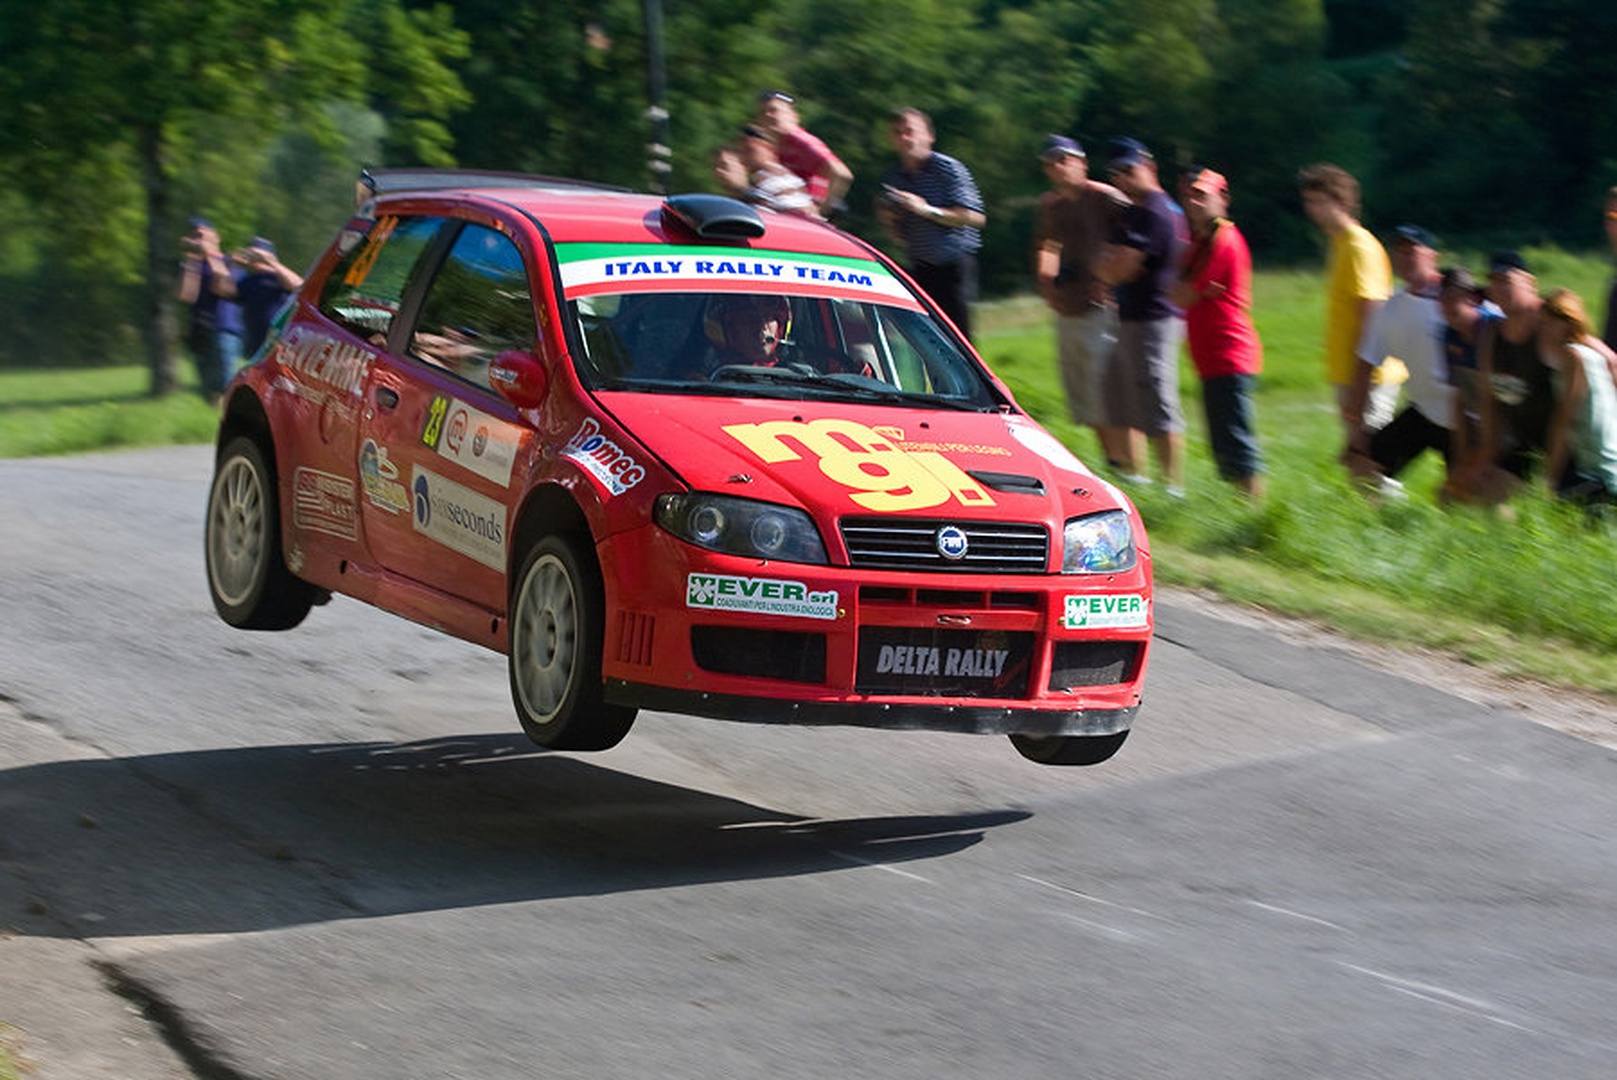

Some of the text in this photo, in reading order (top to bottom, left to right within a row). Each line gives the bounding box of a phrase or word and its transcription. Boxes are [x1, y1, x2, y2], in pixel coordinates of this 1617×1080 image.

[605, 260, 874, 287] ITALY RALLY TEAM
[423, 396, 447, 447] 23
[570, 418, 644, 487] Romec
[718, 579, 835, 604] EVER srl
[1089, 598, 1140, 613] EVER
[876, 645, 1008, 677] DELTA RALLY
